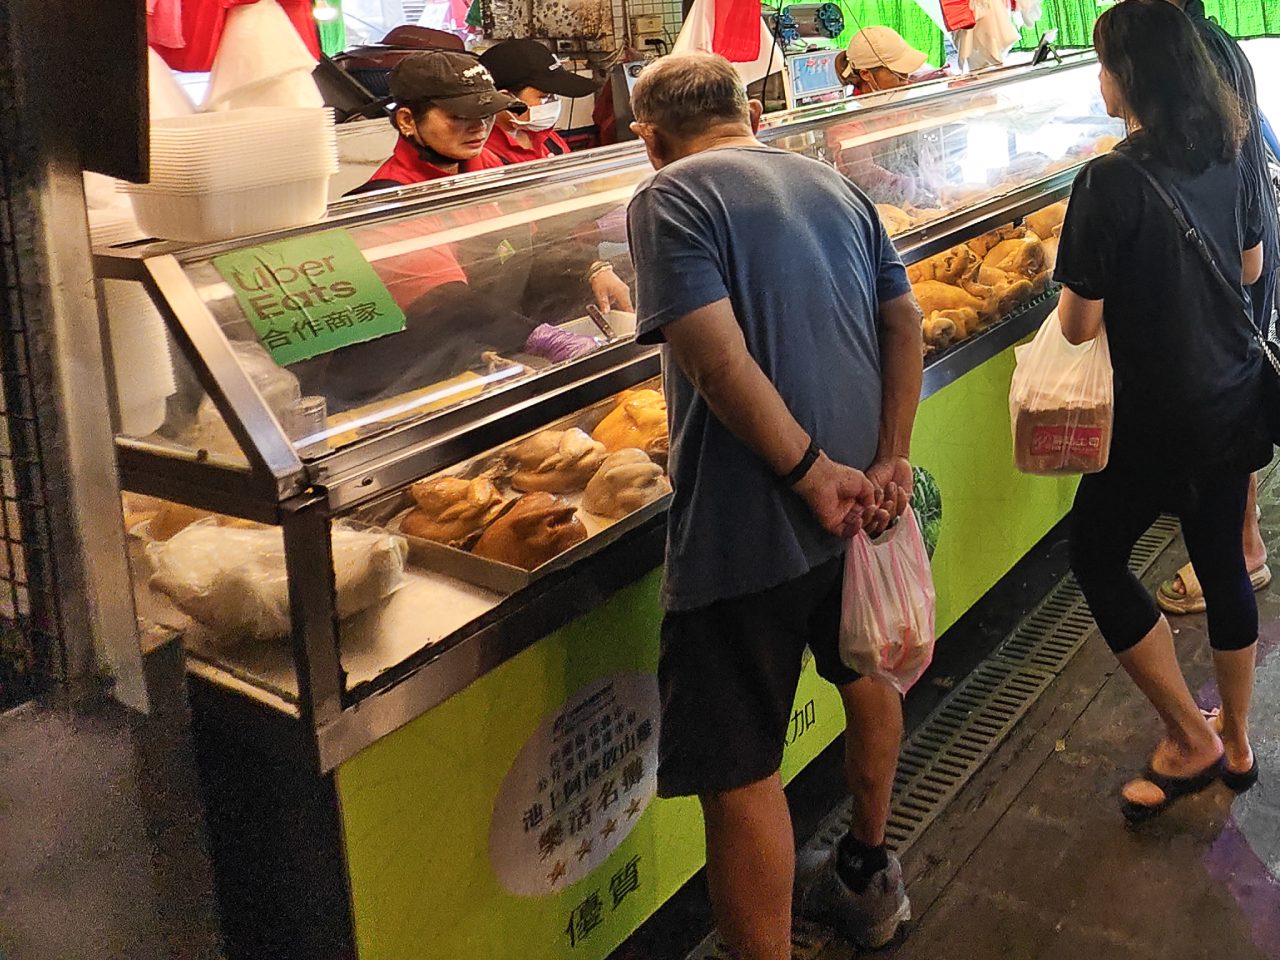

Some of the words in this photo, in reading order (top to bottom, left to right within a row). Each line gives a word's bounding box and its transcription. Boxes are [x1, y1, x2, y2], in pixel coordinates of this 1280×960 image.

[249, 279, 358, 321] Eats
[261, 301, 385, 352] 合作商家
[783, 699, 817, 748] 加
